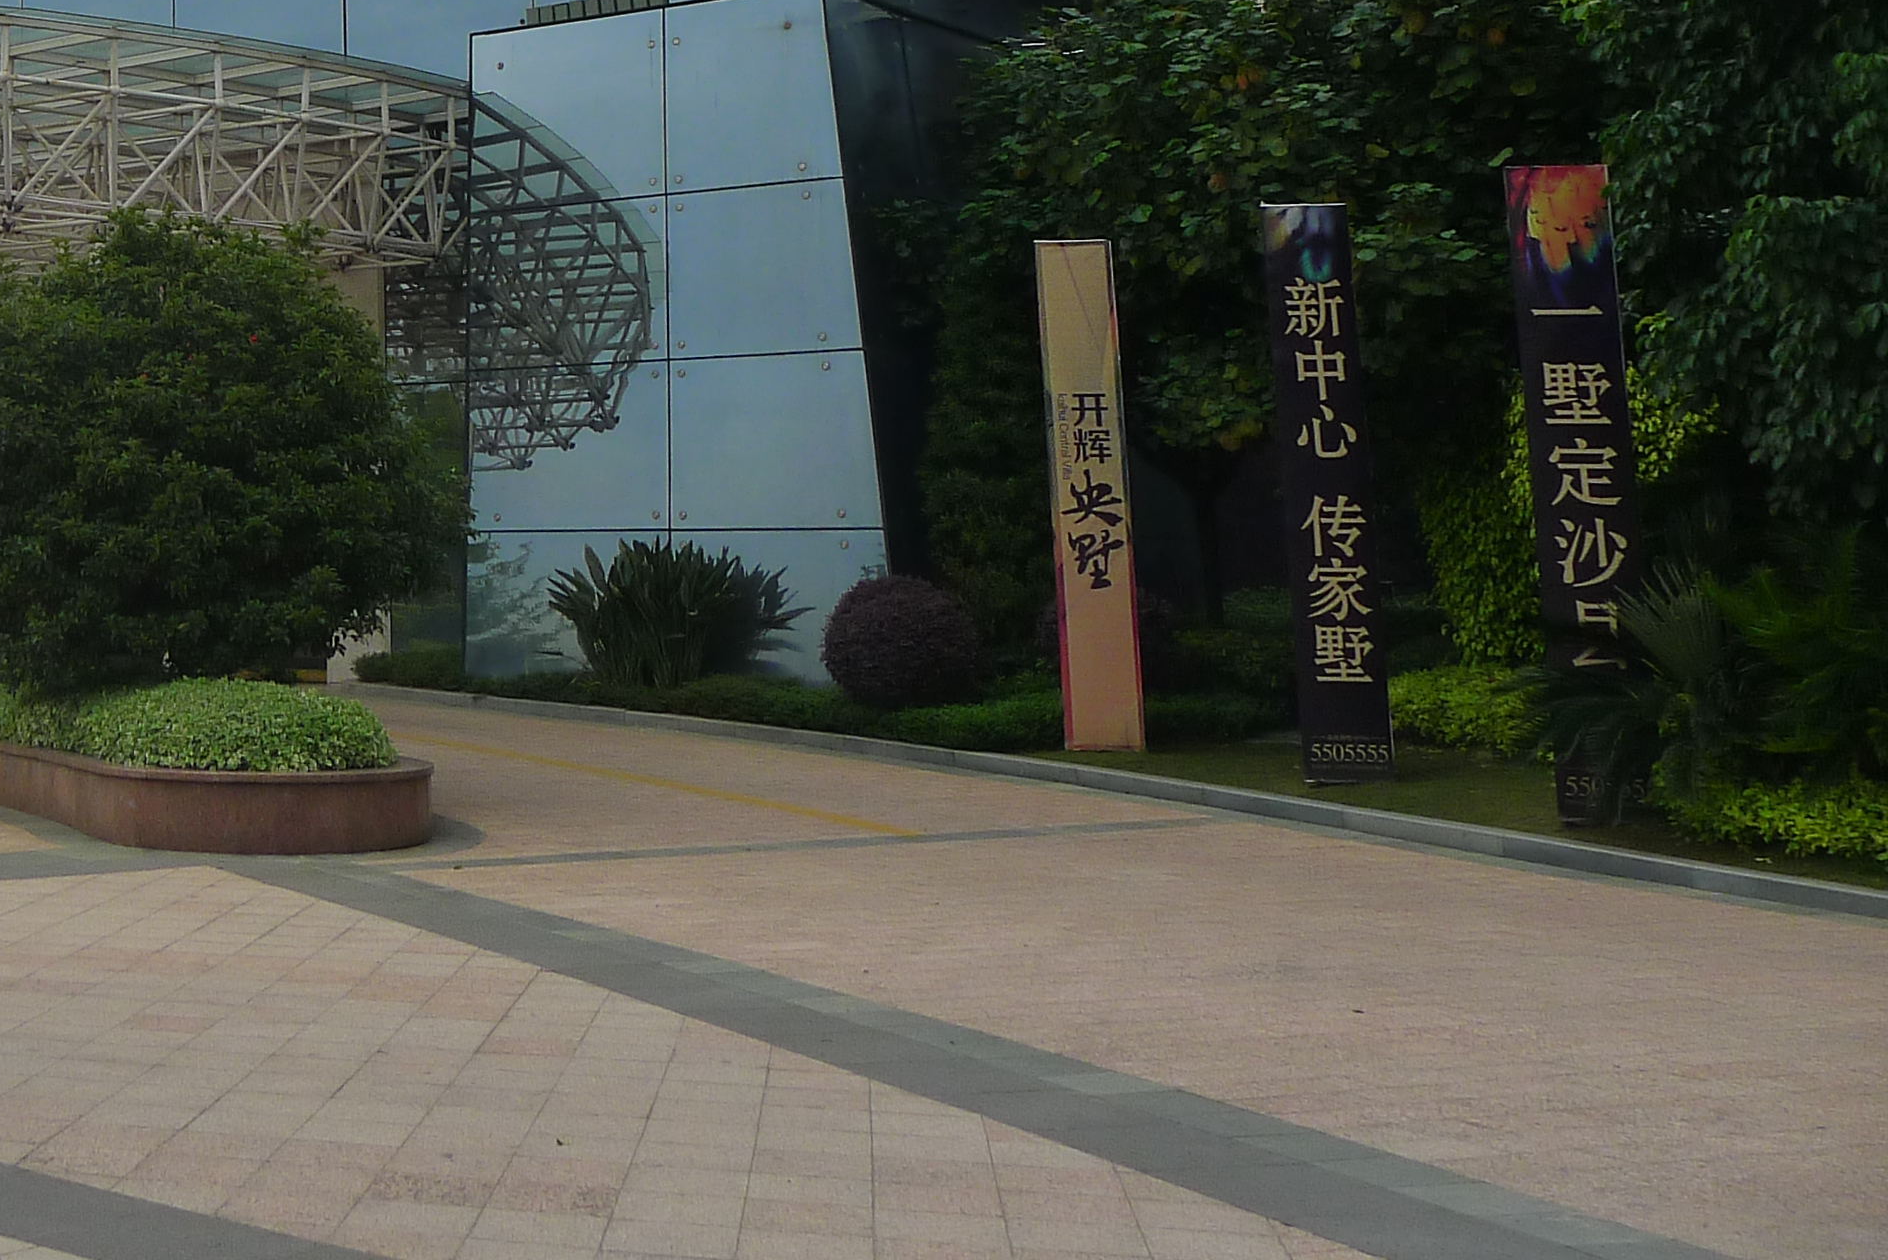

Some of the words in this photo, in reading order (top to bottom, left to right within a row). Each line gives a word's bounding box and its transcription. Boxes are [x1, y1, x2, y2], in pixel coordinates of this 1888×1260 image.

[1282, 275, 1358, 460] 新中心
[1061, 393, 1125, 590] 开辉央墅
[1300, 495, 1374, 683] 传家墅
[1311, 743, 1389, 763] 5505555
